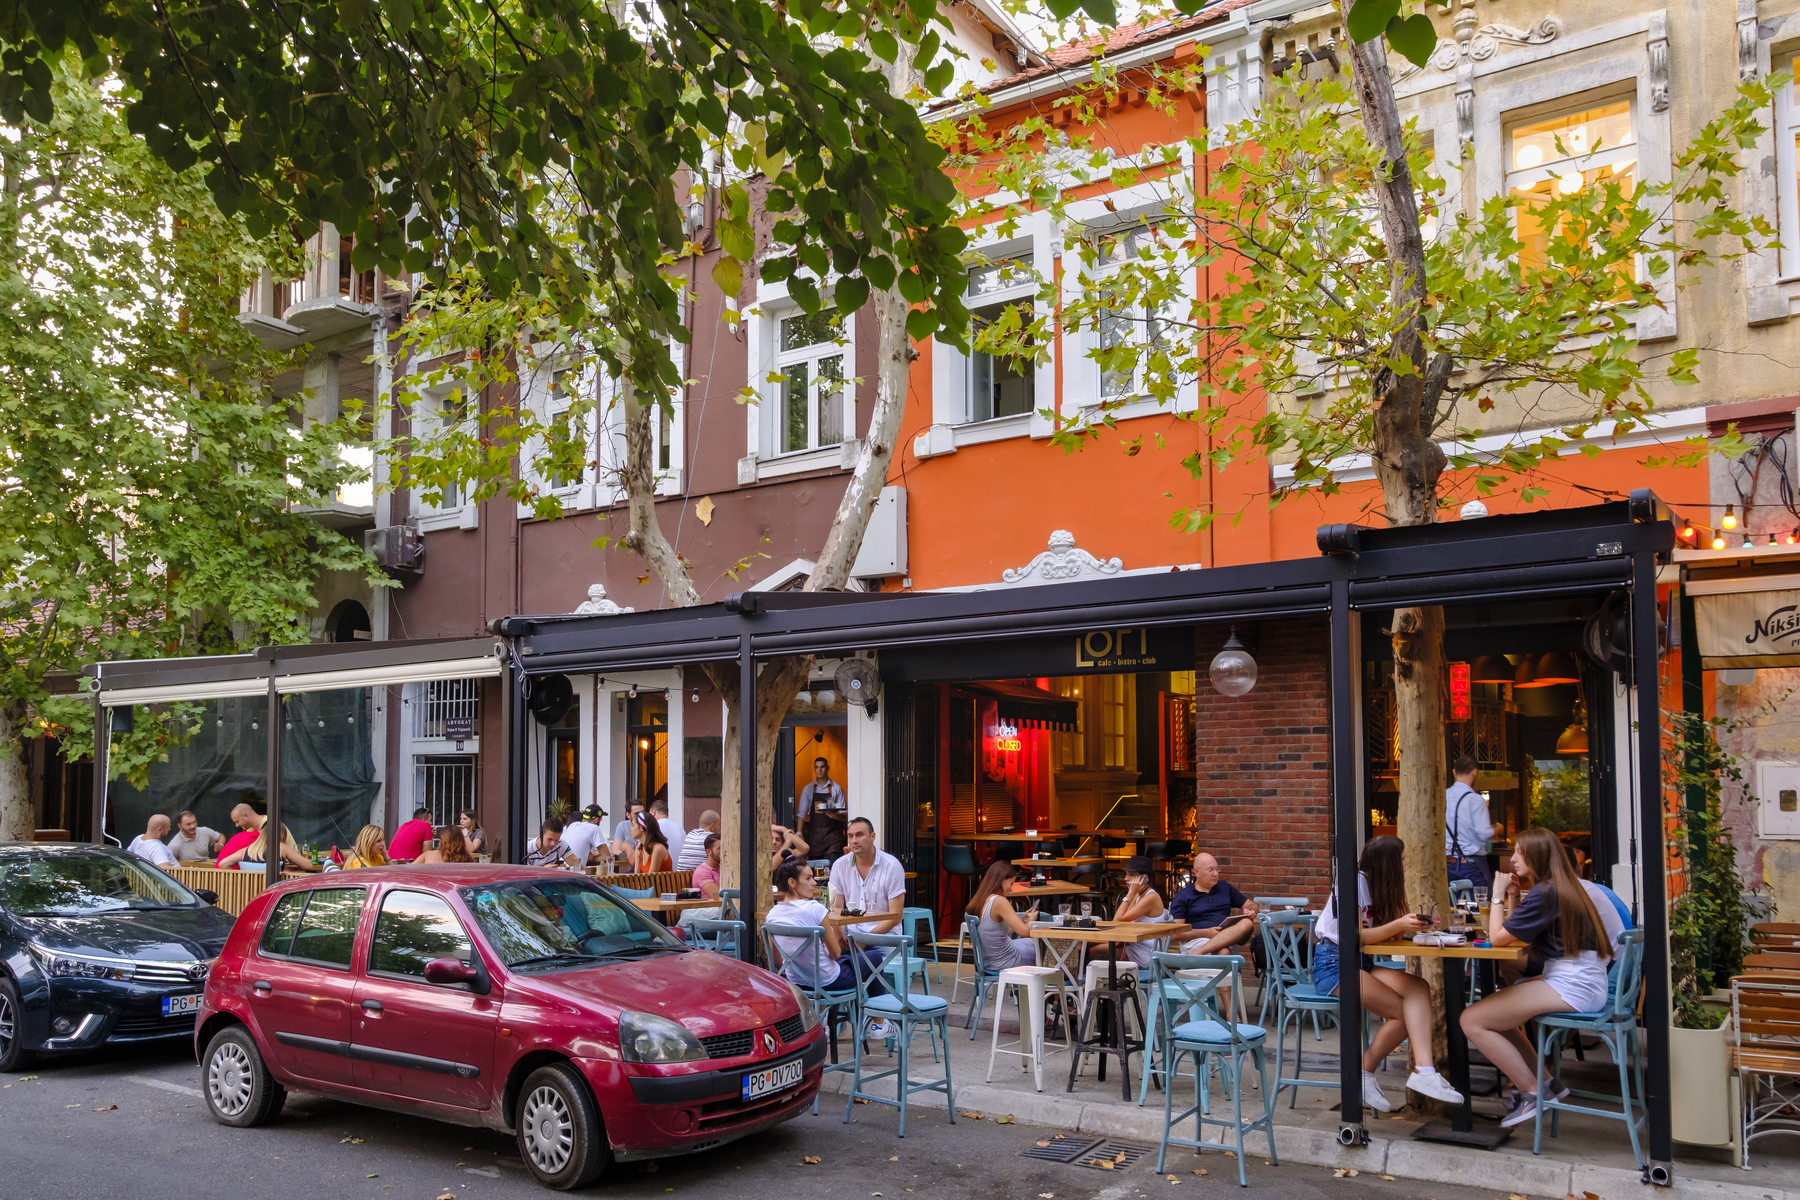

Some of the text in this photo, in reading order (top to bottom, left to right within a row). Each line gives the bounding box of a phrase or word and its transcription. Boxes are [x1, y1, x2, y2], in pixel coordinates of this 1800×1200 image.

[1118, 658, 1137, 666] bistro
[1142, 656, 1157, 665] club
[1000, 725, 1018, 737] OPEN
[457, 742, 464, 750] 10
[997, 739, 1021, 751] CLOSED
[172, 997, 187, 1011] PG
[751, 1073, 765, 1094] PG
[772, 1062, 802, 1087] DV700
